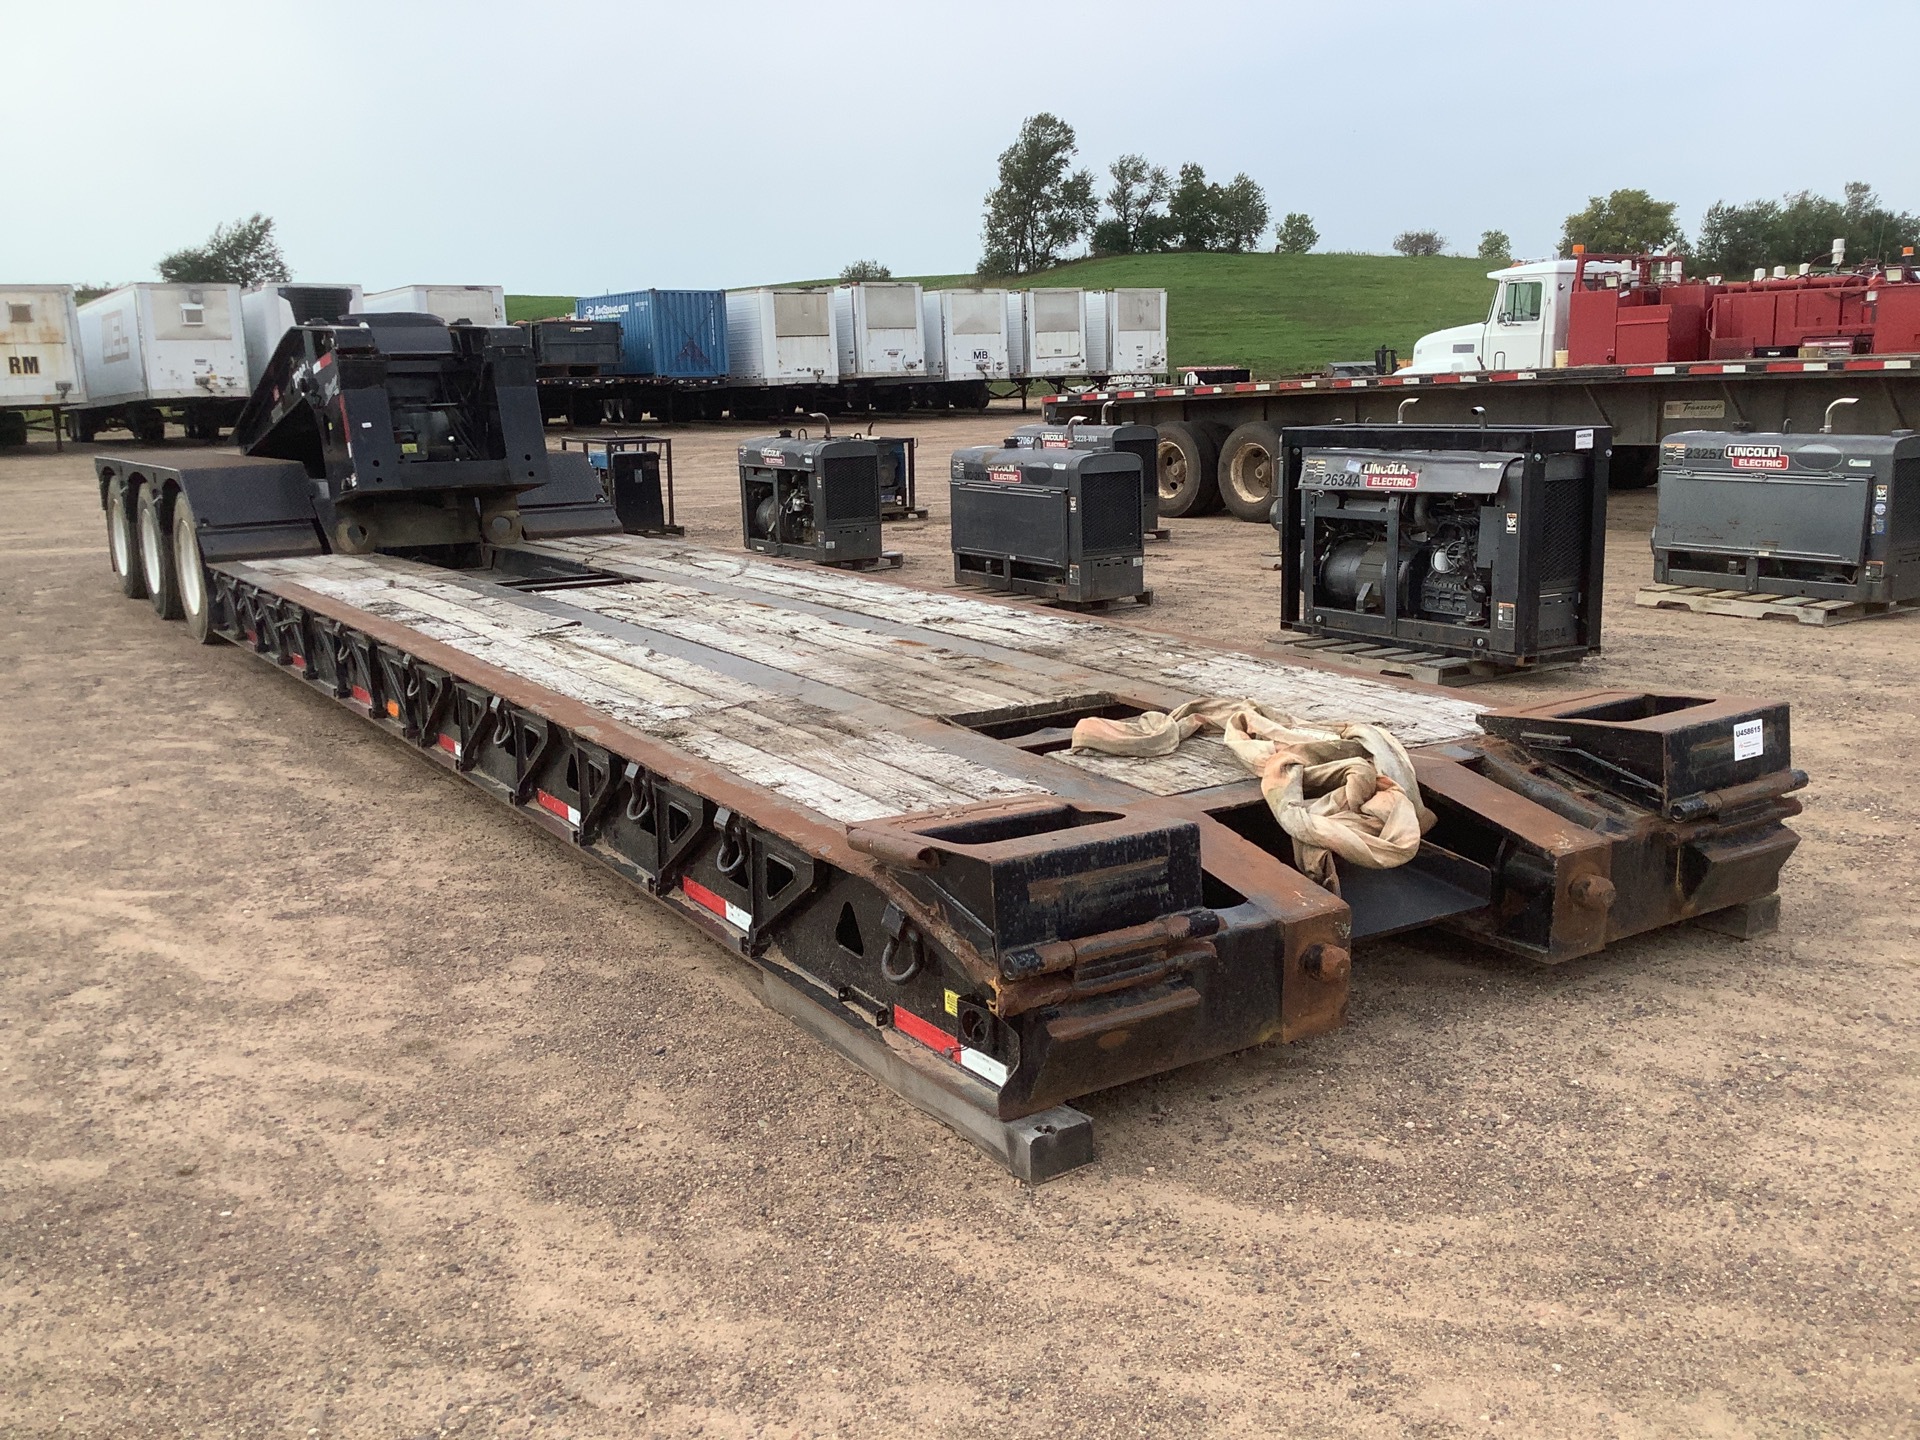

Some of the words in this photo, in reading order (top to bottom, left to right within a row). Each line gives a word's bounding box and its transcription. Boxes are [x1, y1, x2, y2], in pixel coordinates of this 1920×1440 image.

[973, 350, 988, 360] MB
[8, 356, 40, 375] RM
[1041, 433, 1065, 442] LINCOLN
[1685, 447, 1724, 460] 23257
[1727, 446, 1778, 458] LINCOLN
[1363, 462, 1409, 475] LINCOLN
[1738, 458, 1783, 468] ELECTRIC
[993, 472, 1019, 482] ELECTRIC
[1323, 473, 1361, 487] 2634A
[1371, 476, 1413, 487] ELECTRIC
[1735, 725, 1761, 738] U458615
